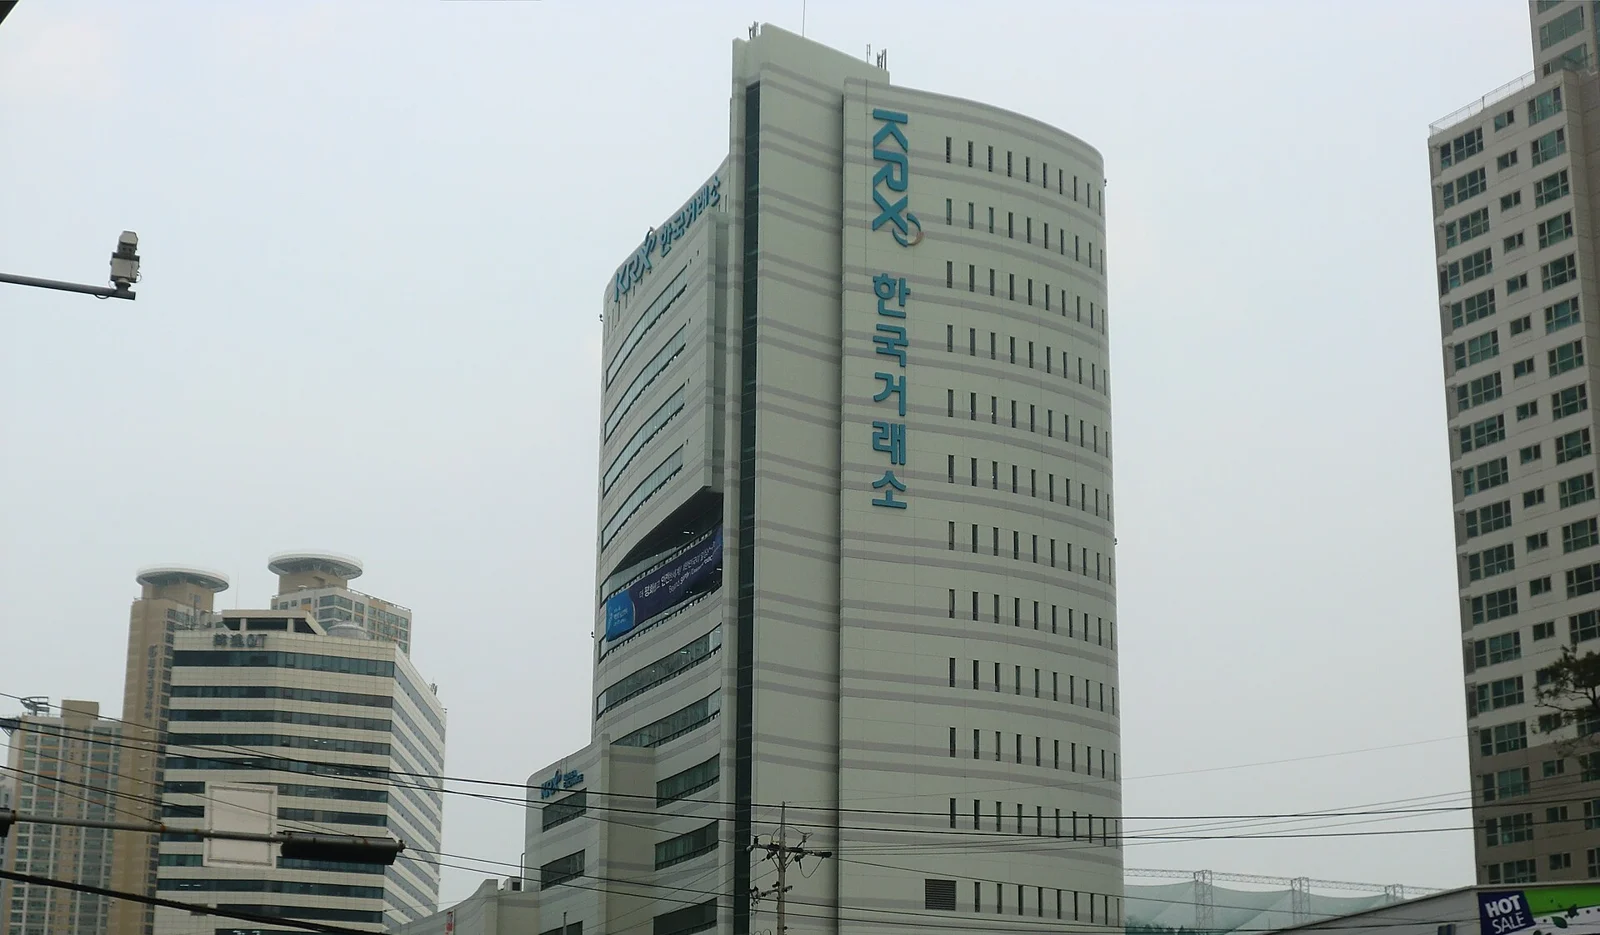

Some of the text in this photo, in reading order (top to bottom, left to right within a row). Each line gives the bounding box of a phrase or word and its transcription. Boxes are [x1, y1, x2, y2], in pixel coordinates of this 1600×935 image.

[872, 108, 910, 238] KRX
[660, 176, 721, 258] 한국거래소
[614, 231, 657, 303] KRX
[872, 272, 911, 510] 한국거래소
[1485, 895, 1522, 918] HOT
[1492, 912, 1527, 934] SALE
